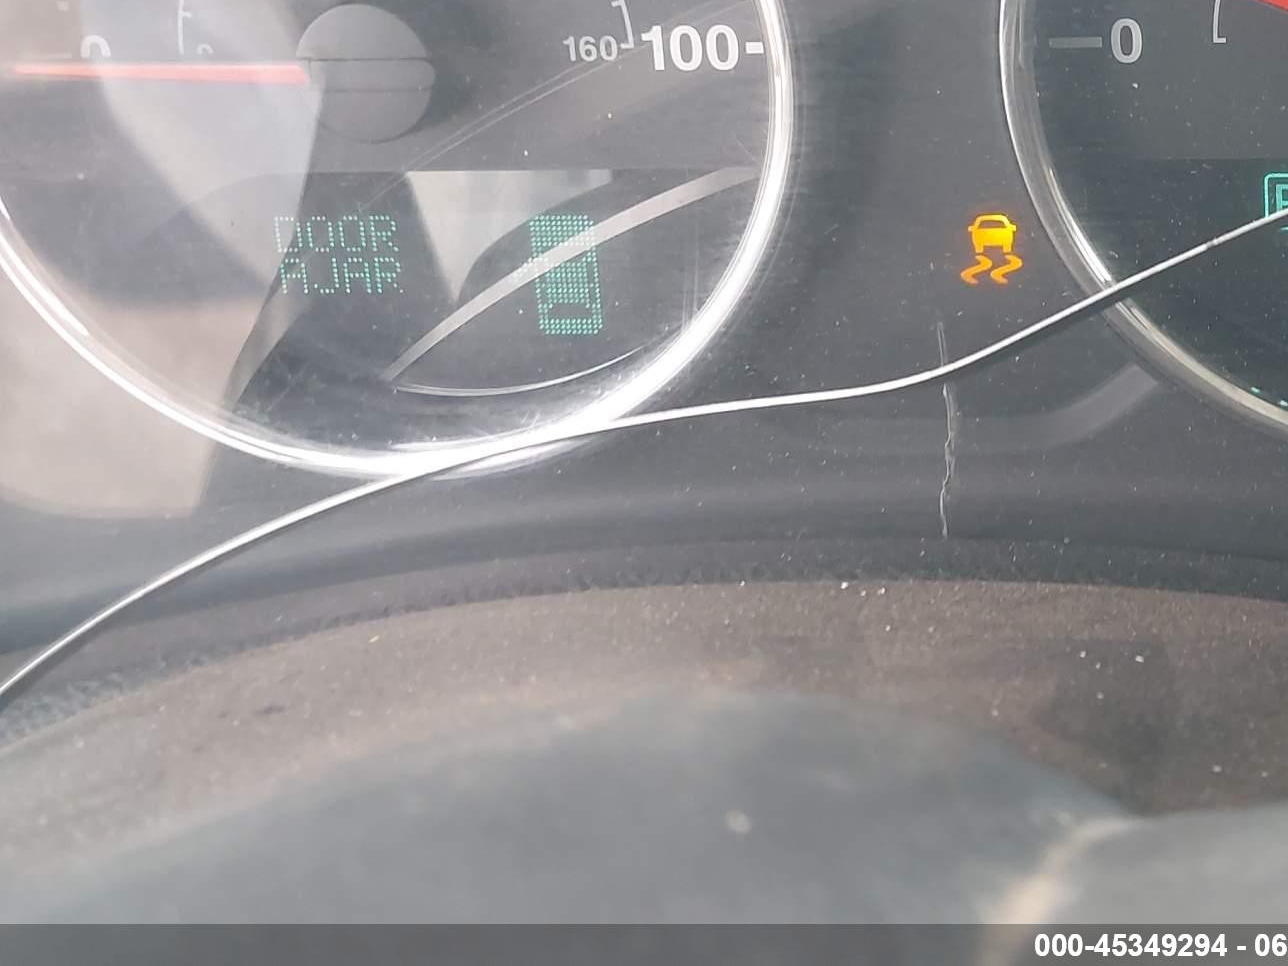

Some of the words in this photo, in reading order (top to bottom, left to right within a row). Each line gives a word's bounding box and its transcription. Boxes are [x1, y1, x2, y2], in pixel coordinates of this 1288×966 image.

[563, 35, 618, 63] 160
[641, 25, 739, 72] 100
[1110, 18, 1143, 63] 0
[274, 216, 400, 253] DOOR
[280, 257, 402, 295] AJAR
